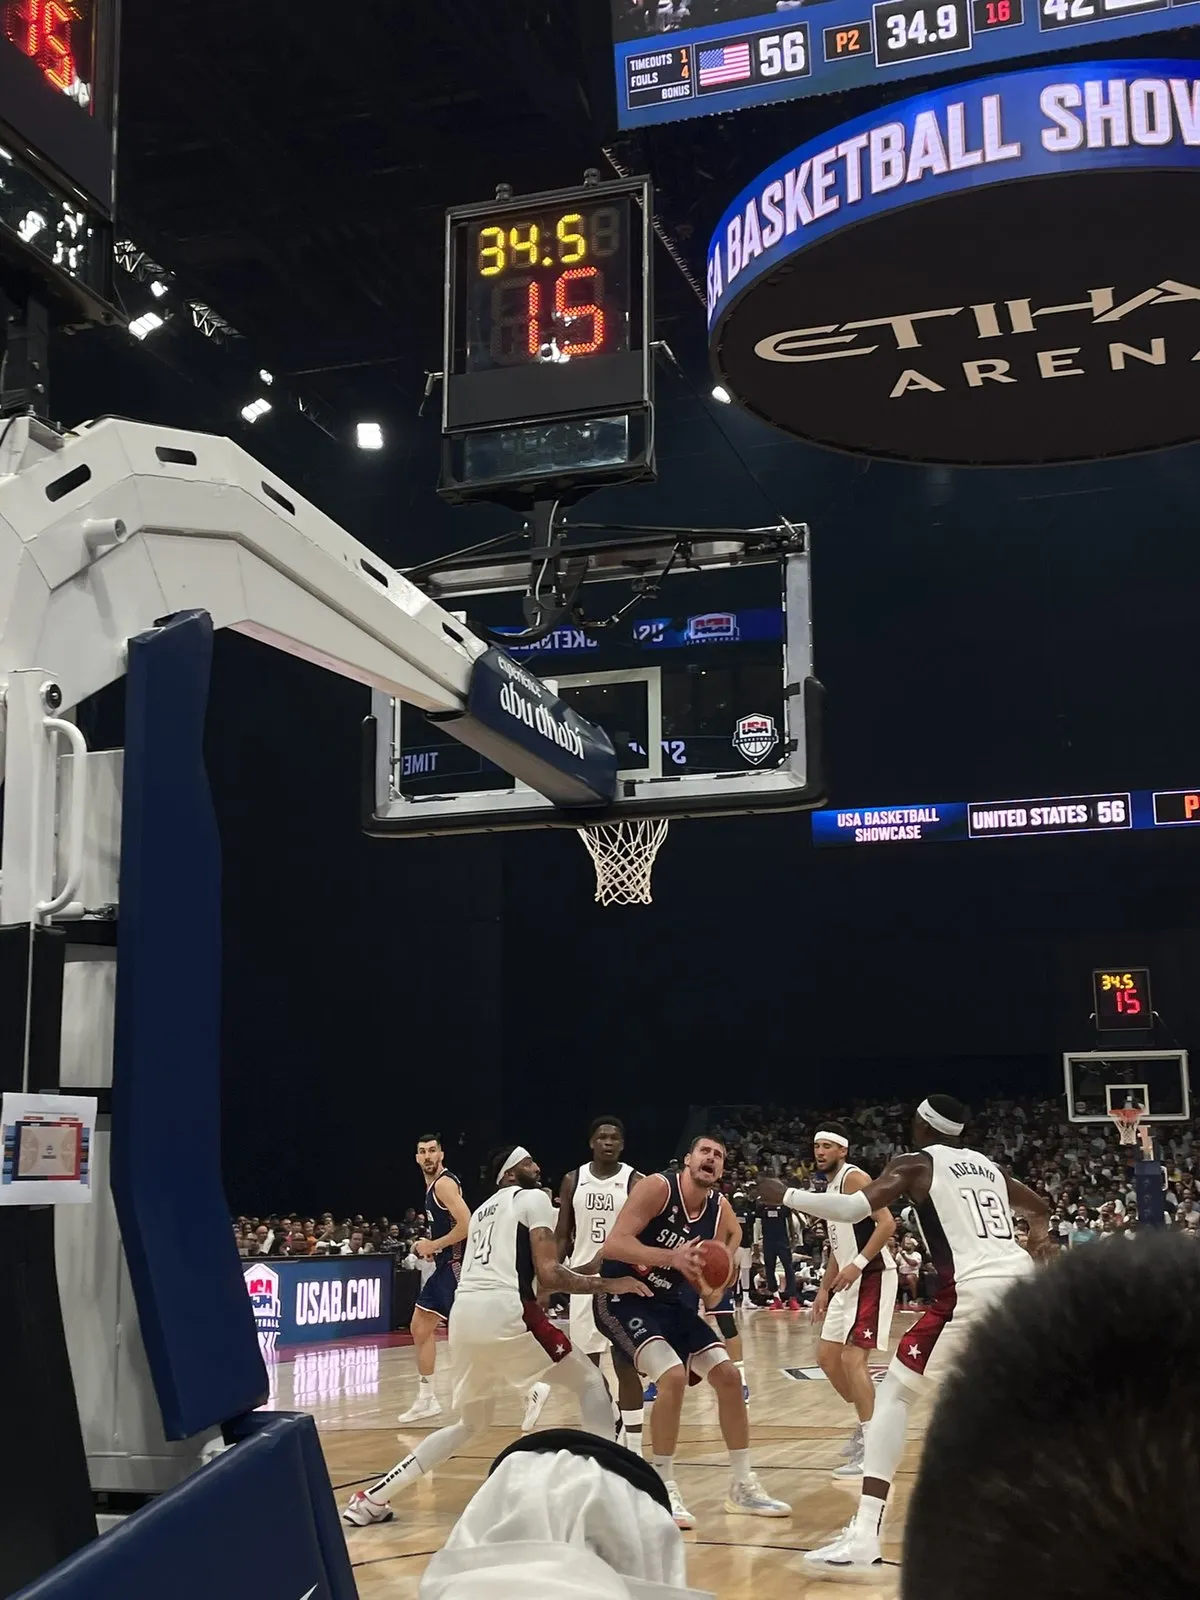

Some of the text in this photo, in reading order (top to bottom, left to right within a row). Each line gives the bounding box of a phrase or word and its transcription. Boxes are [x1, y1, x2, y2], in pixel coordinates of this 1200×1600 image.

[986, 1, 1010, 25] 16
[886, 4, 957, 50] 34.9
[758, 31, 805, 77] 56
[835, 30, 860, 53] P2
[630, 49, 689, 71] TIMEOUTS 1
[631, 65, 689, 88] FOULS 4
[661, 84, 690, 100] BONUS
[707, 241, 723, 330] SA
[727, 94, 1021, 283] BASKETBALL
[480, 213, 586, 276] 34.5
[528, 266, 604, 355] 15
[889, 337, 1200, 398] AREN
[500, 682, 534, 730] abu
[535, 704, 584, 760] dhabi
[837, 807, 940, 827] USA BASKETBALL
[972, 800, 1126, 829] UNITED STATES 56
[855, 825, 922, 842] SHOWCASE
[1102, 974, 1134, 990] 34.5
[1116, 989, 1140, 1014] 15
[949, 1162, 996, 1183] ADEBAYO
[586, 1193, 614, 1211] USA
[959, 1188, 1012, 1240] 13
[591, 1217, 606, 1243] 5
[296, 1278, 381, 1326] USAB.COM
